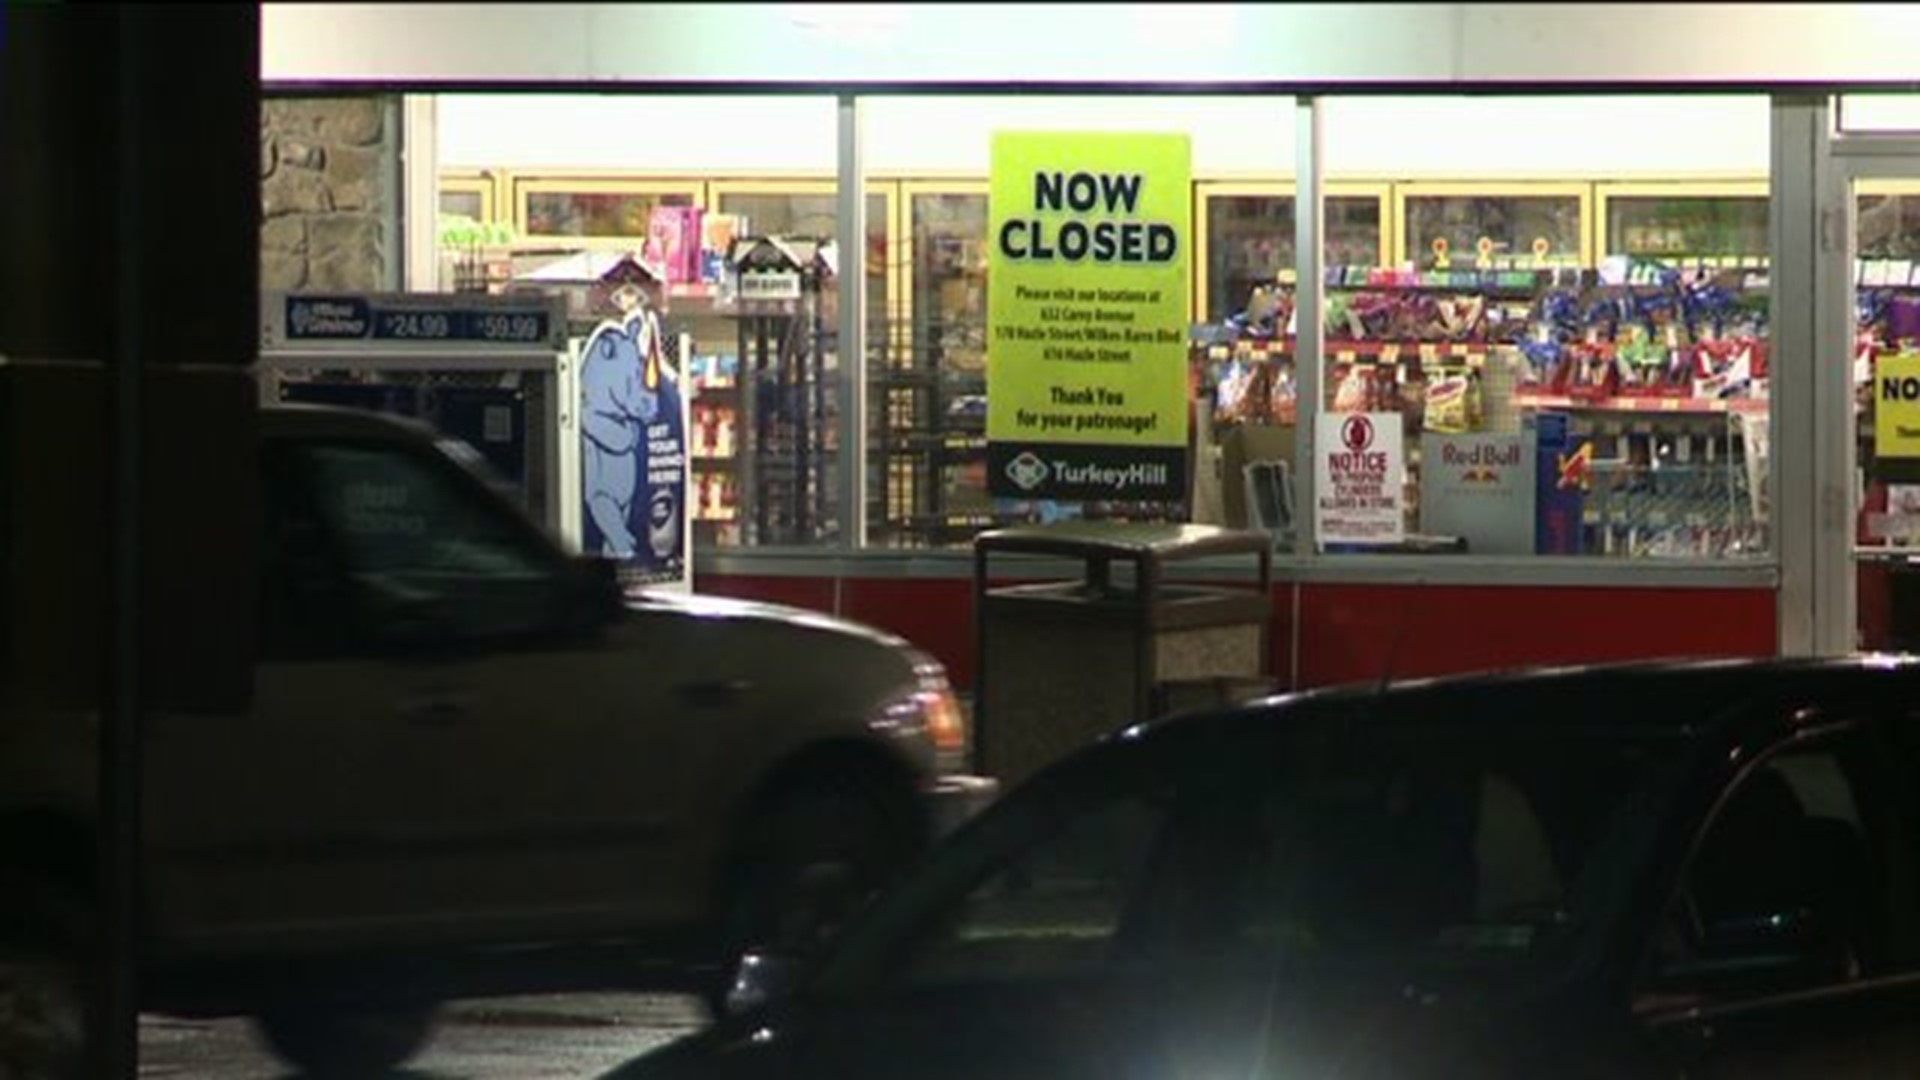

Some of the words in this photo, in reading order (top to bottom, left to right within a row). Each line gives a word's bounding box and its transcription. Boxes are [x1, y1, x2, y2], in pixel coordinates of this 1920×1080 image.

[1035, 172, 1141, 213] NOW
[1000, 220, 1177, 263] CLOSED
[1015, 286, 1051, 300] Please
[1053, 288, 1075, 301] visit
[1078, 291, 1096, 301] our
[1098, 288, 1146, 303] locations
[1149, 290, 1161, 303] at
[1157, 328, 1180, 344] Blvd
[1098, 350, 1131, 363] Street
[1051, 386, 1094, 405] Thank
[1097, 388, 1124, 406] You
[1883, 377, 1920, 400] NO
[1016, 409, 1038, 427] for
[1041, 413, 1072, 431] your
[1076, 413, 1157, 434] patronage!
[1328, 452, 1387, 472] NOTICE
[1442, 442, 1480, 465] Red
[1483, 444, 1521, 466] Bull
